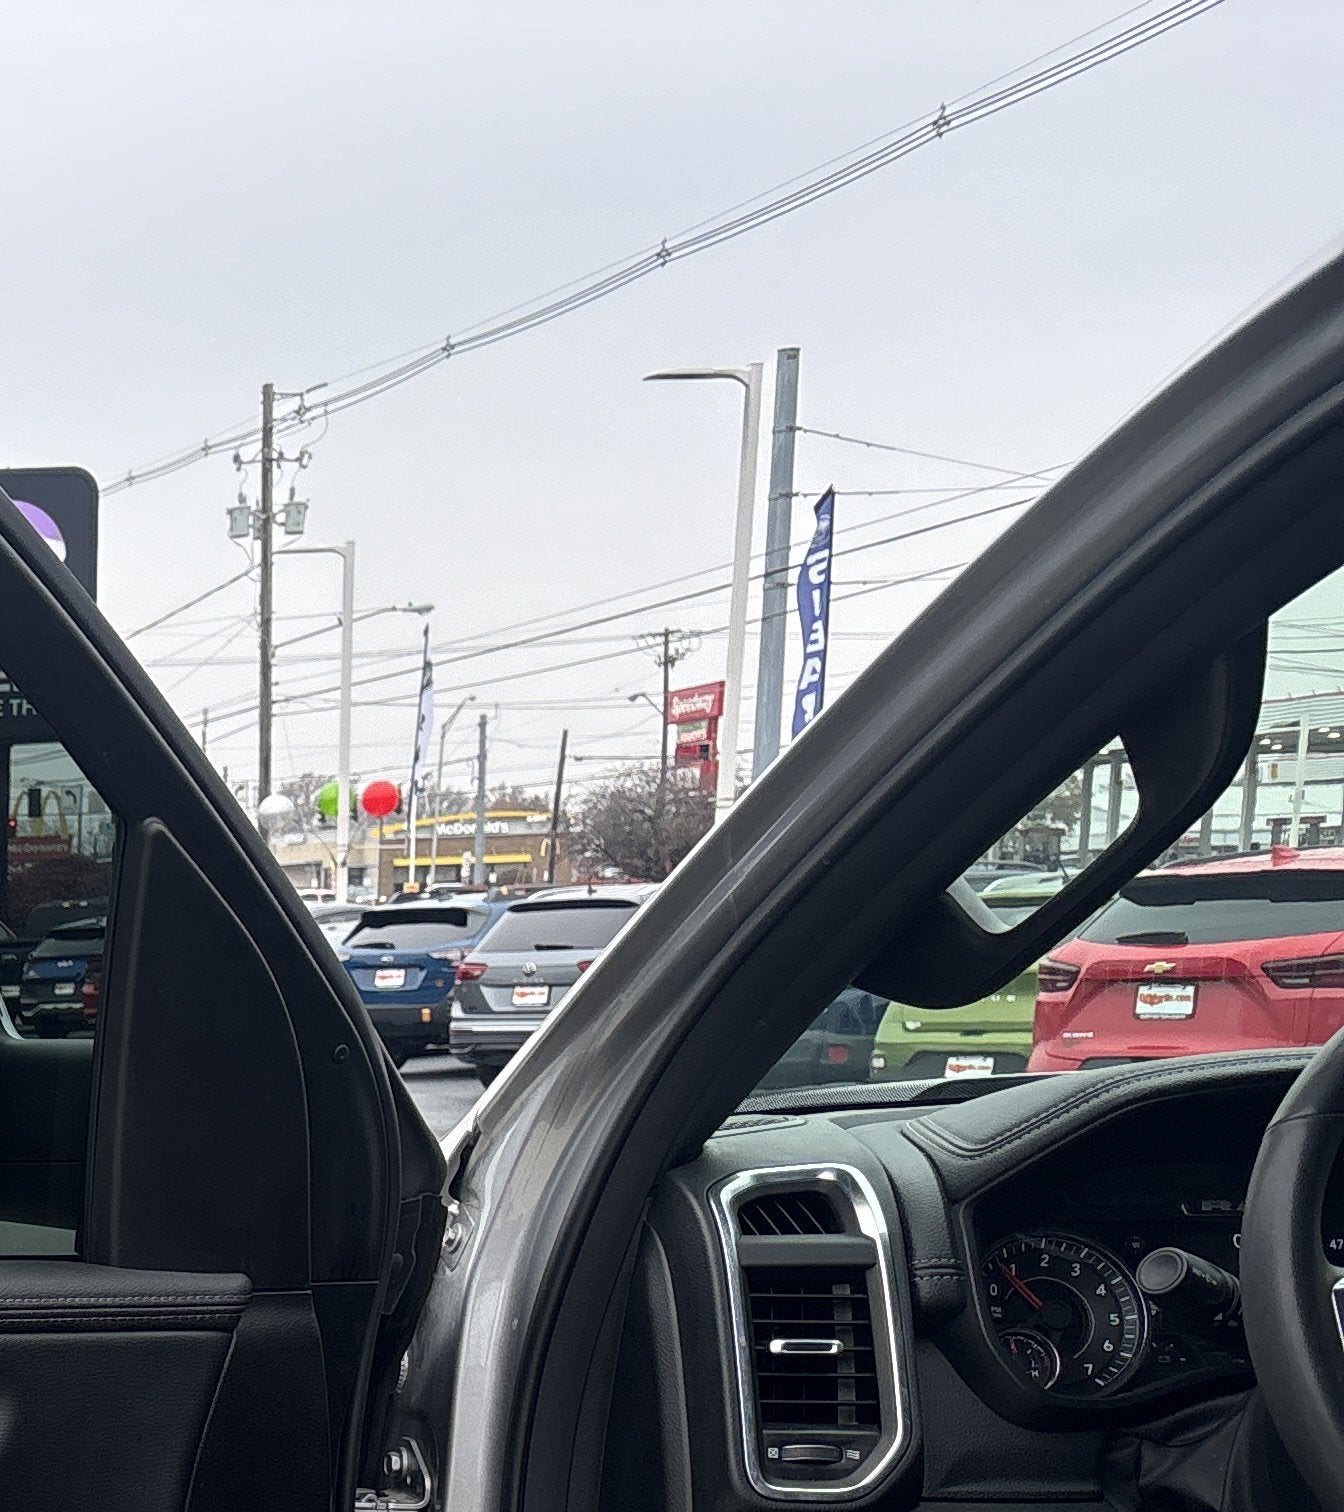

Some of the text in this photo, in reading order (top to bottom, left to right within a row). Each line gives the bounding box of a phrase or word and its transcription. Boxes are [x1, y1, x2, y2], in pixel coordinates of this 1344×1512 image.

[1040, 1254, 1050, 1267] 2
[1010, 1264, 1016, 1276] 1
[1071, 1263, 1081, 1277] 3
[989, 1284, 998, 1296] 0
[1095, 1284, 1107, 1297] 4
[1109, 1313, 1120, 1326] 5
[1103, 1339, 1114, 1352] 6
[1083, 1363, 1093, 1376] 7
